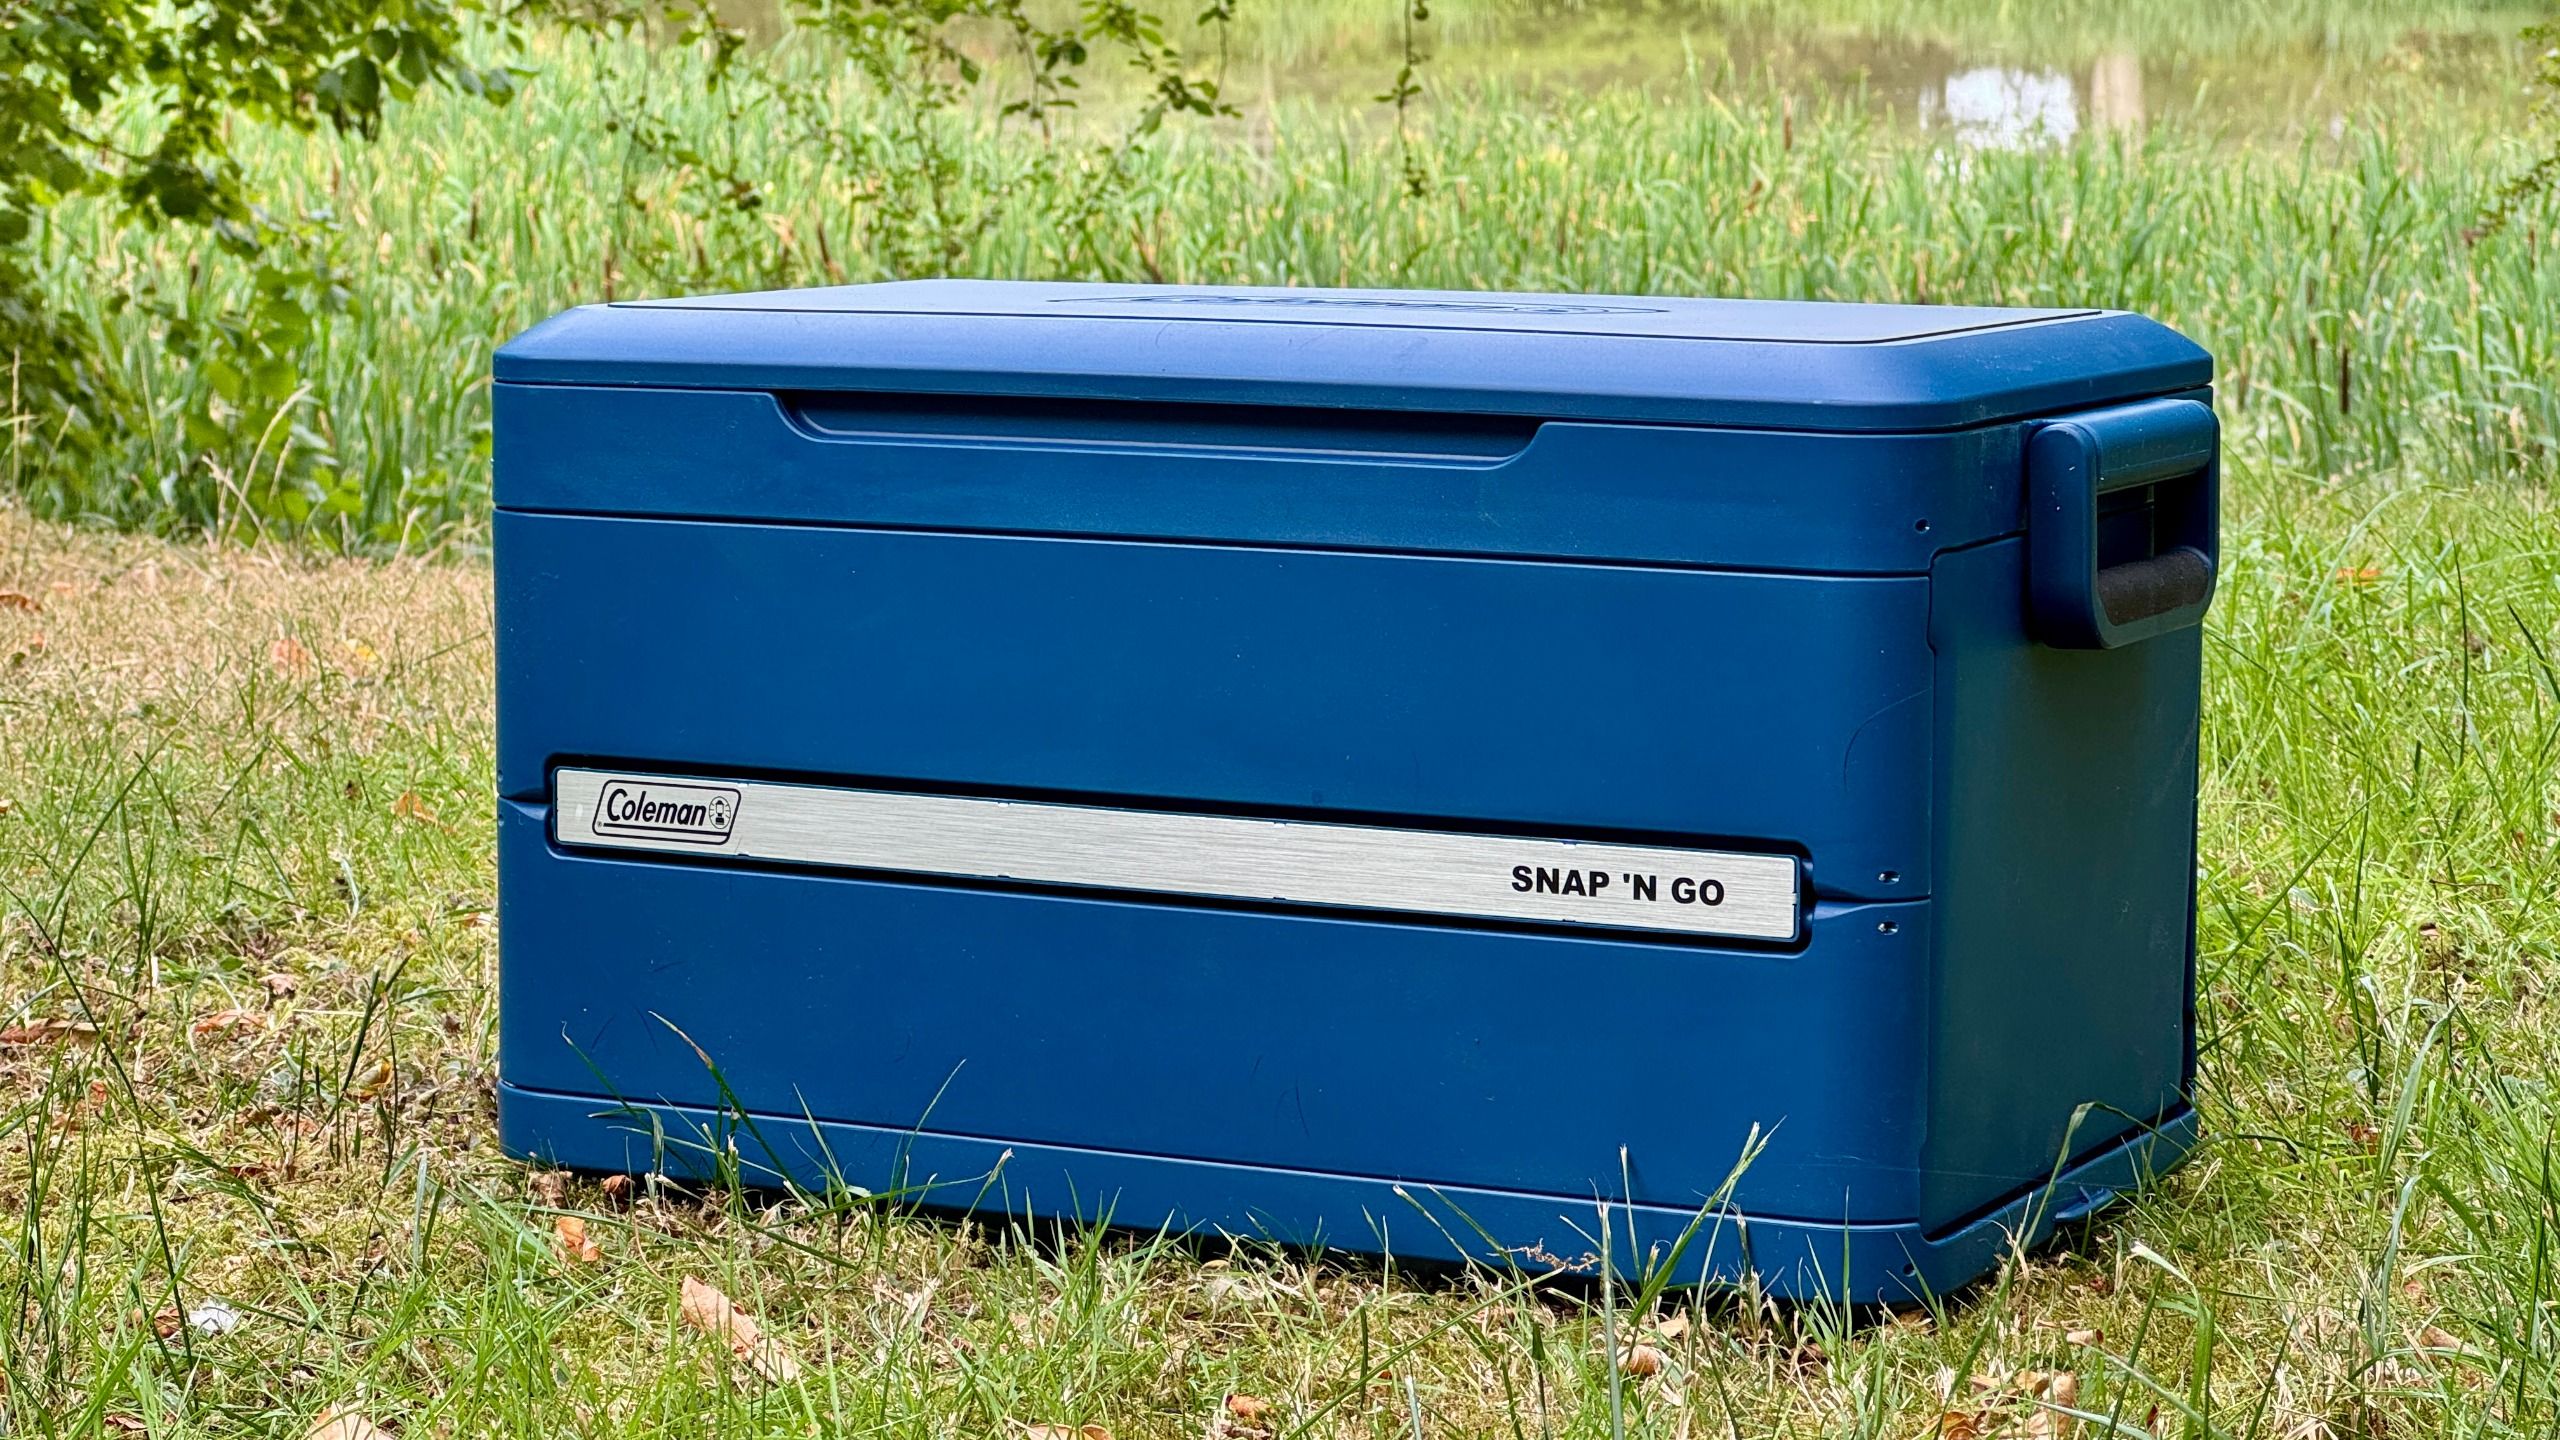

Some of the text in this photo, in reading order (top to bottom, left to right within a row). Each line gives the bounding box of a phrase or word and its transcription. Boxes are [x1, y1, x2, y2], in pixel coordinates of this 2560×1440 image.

[607, 788, 707, 826] Coleman
[1511, 865, 1725, 906] SNAP 'N GO
